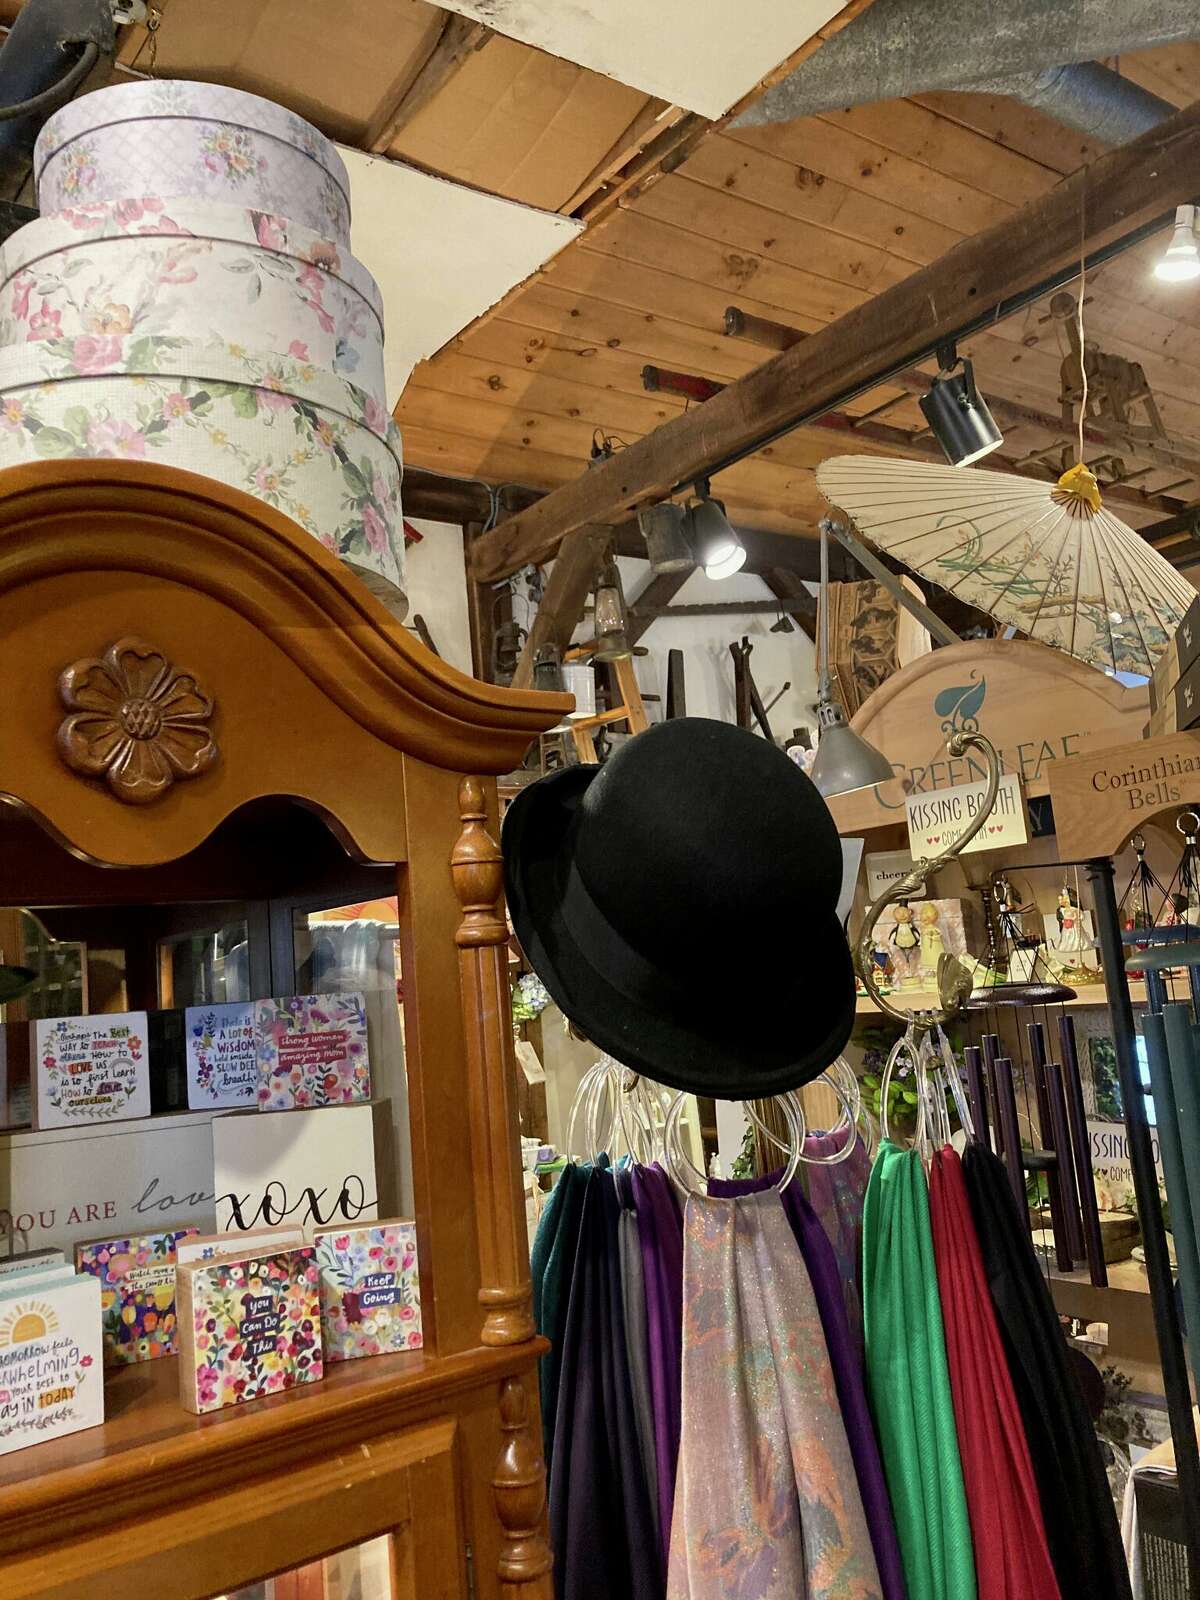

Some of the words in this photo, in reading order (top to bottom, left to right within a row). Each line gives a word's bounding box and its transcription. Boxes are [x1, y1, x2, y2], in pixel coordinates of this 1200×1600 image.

[1126, 782, 1181, 810] Bells
[909, 797, 962, 833] KISSING
[876, 869, 912, 881] cheer
[219, 1029, 226, 1040] A
[282, 1035, 309, 1048] strong
[311, 1034, 344, 1043] women
[60, 1043, 77, 1053] WAY
[240, 1059, 256, 1071] DEE
[280, 1051, 321, 1064] amazing
[223, 1071, 256, 1086] breath
[66, 1201, 117, 1225] ARE
[131, 1177, 216, 1214] lov
[215, 1175, 379, 1232] xoxo
[242, 1322, 262, 1334] Can
[264, 1316, 278, 1328] Do
[252, 1340, 273, 1355] This
